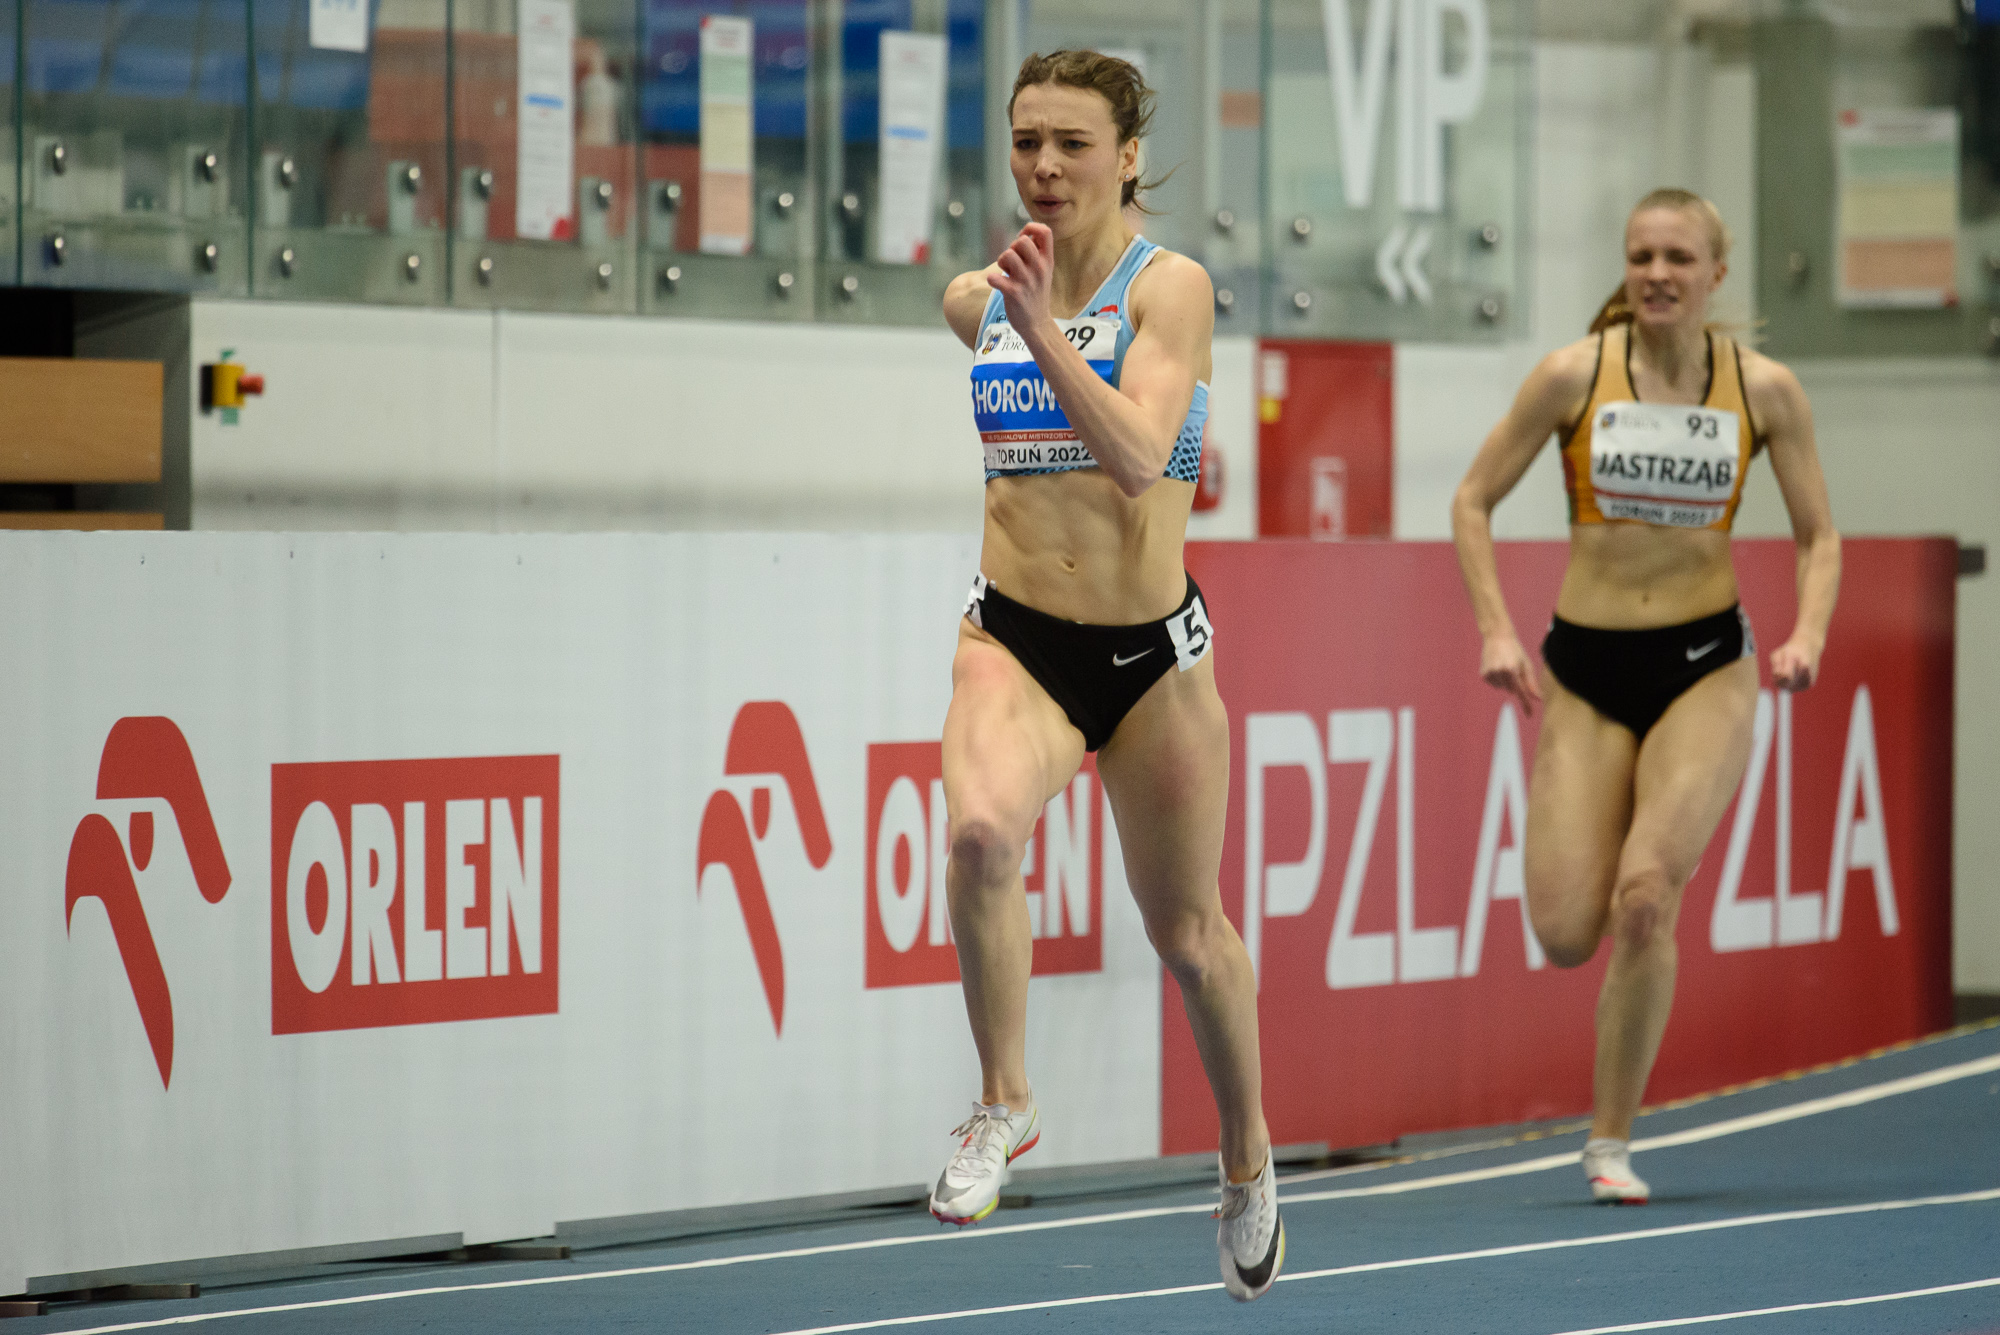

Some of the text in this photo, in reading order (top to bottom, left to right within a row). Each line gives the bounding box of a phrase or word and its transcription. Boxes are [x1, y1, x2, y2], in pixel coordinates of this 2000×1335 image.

[1322, 0, 1489, 211] VIP
[974, 378, 1061, 414] HOROW
[1686, 414, 1719, 439] 93
[997, 443, 1092, 464] TORUŃ 2022
[1596, 453, 1731, 493] JASTRZĄB
[1183, 606, 1208, 656] 5
[1709, 684, 1900, 954] ZLA
[1243, 702, 1547, 994] PZLA
[286, 796, 543, 994] ORLEN
